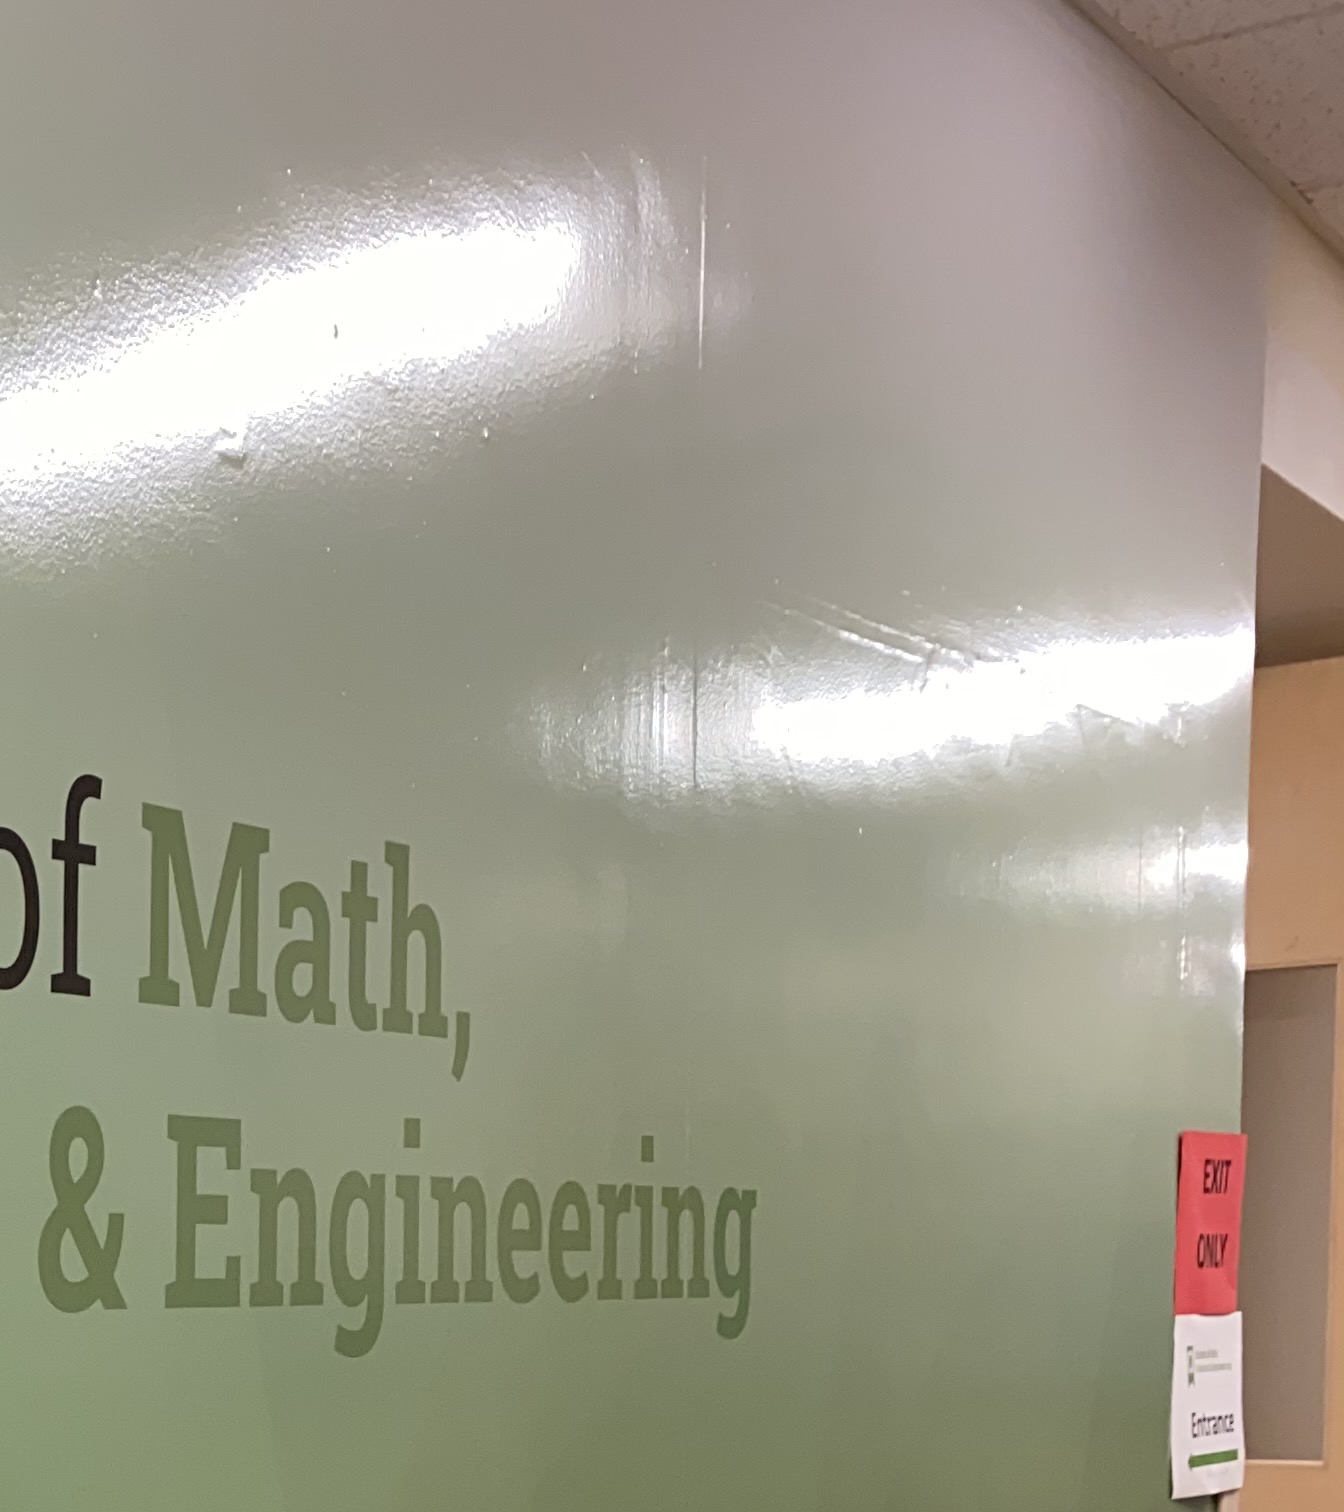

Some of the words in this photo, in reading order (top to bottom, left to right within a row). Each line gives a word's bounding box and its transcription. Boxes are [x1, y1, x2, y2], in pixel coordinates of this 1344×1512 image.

[138, 802, 472, 1082] Math,
[1202, 1158, 1232, 1195] EXIT
[37, 1105, 128, 1314] &
[164, 1114, 758, 1359] Engineering
[1196, 1233, 1229, 1270] ONLY
[1191, 1411, 1235, 1439] Entrance
